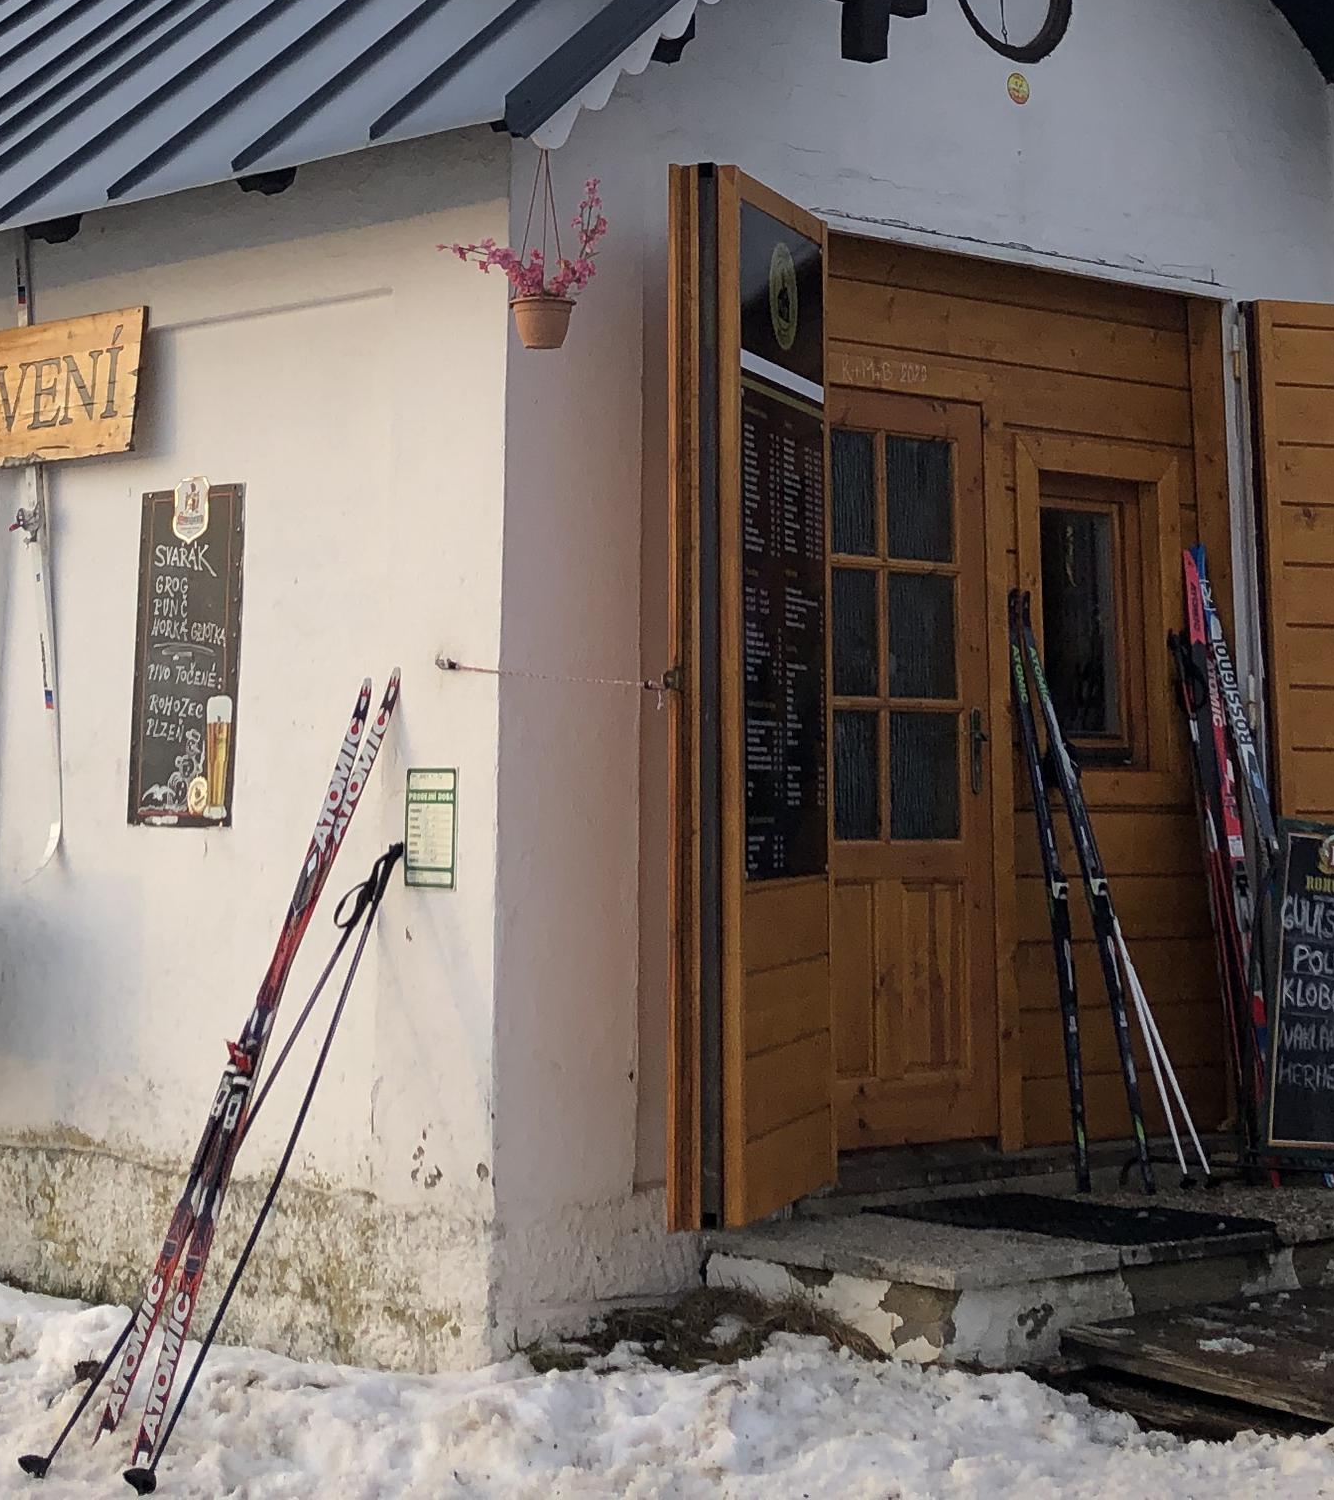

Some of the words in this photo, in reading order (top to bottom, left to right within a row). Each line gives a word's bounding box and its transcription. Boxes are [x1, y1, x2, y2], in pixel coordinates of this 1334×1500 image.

[153, 594, 189, 618] PUNČ
[155, 575, 189, 598] GROG
[147, 663, 171, 683] PIVO
[149, 694, 204, 718] ROHOZEC
[1012, 644, 1029, 703] ATOMIC
[1213, 639, 1255, 746] ROSSIGNOL
[314, 716, 364, 852] ATOMIC
[333, 708, 390, 845] ATOMIC
[109, 1275, 164, 1426] ATOMIC
[143, 1291, 191, 1447] ATOMIC
